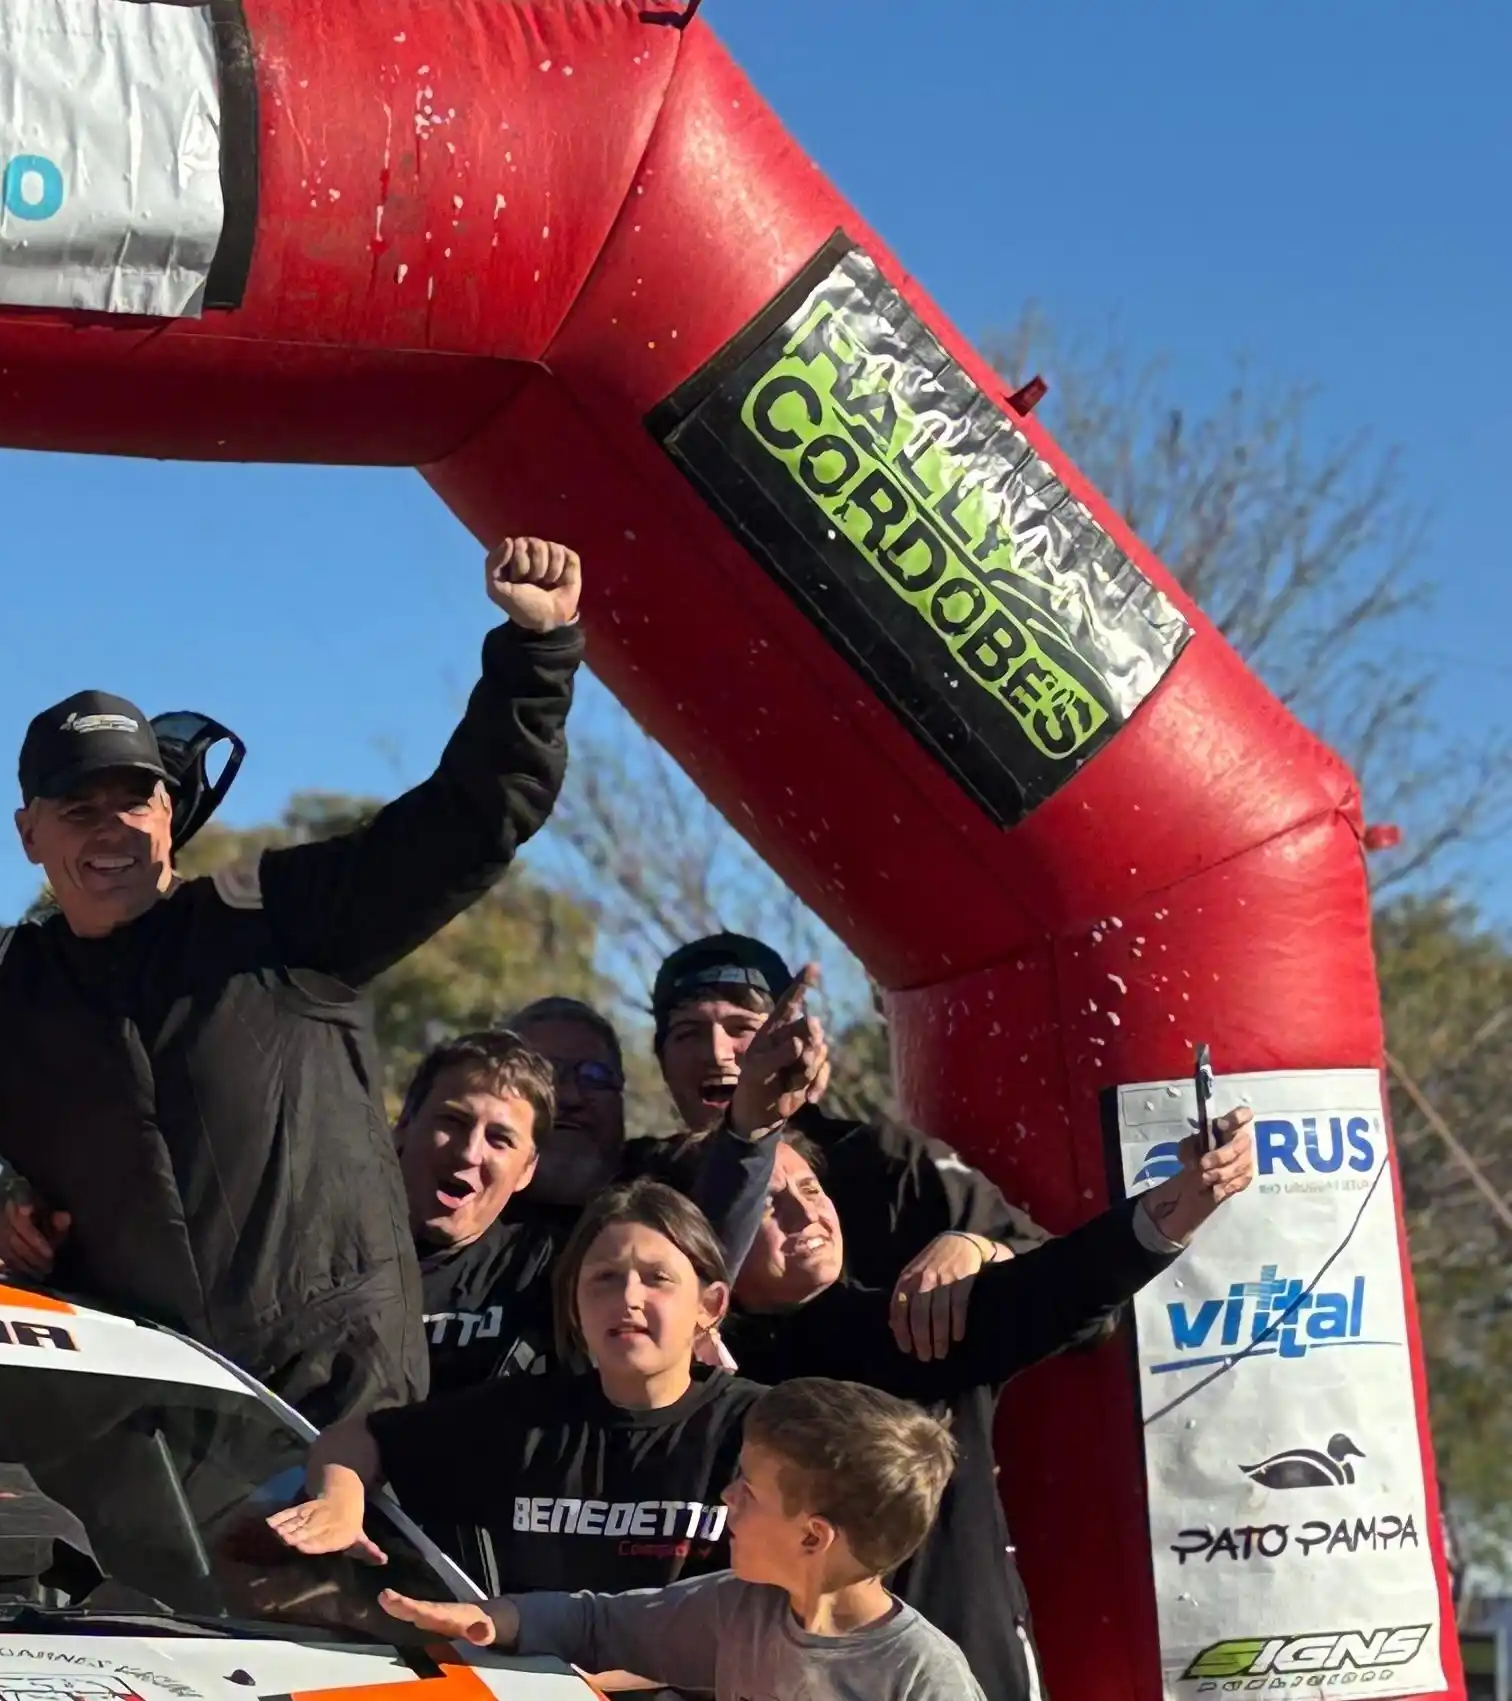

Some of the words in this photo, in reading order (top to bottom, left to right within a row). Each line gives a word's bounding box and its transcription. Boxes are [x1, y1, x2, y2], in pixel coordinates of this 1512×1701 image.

[1254, 1115, 1375, 1176] RUS
[422, 1305, 504, 1347] TTO
[1166, 1264, 1366, 1359] vittal
[512, 1496, 729, 1542] BENEDETTO
[1170, 1523, 1290, 1565] PATO
[1295, 1513, 1419, 1557] PAMPA
[1178, 1623, 1433, 1681] SIGNS
